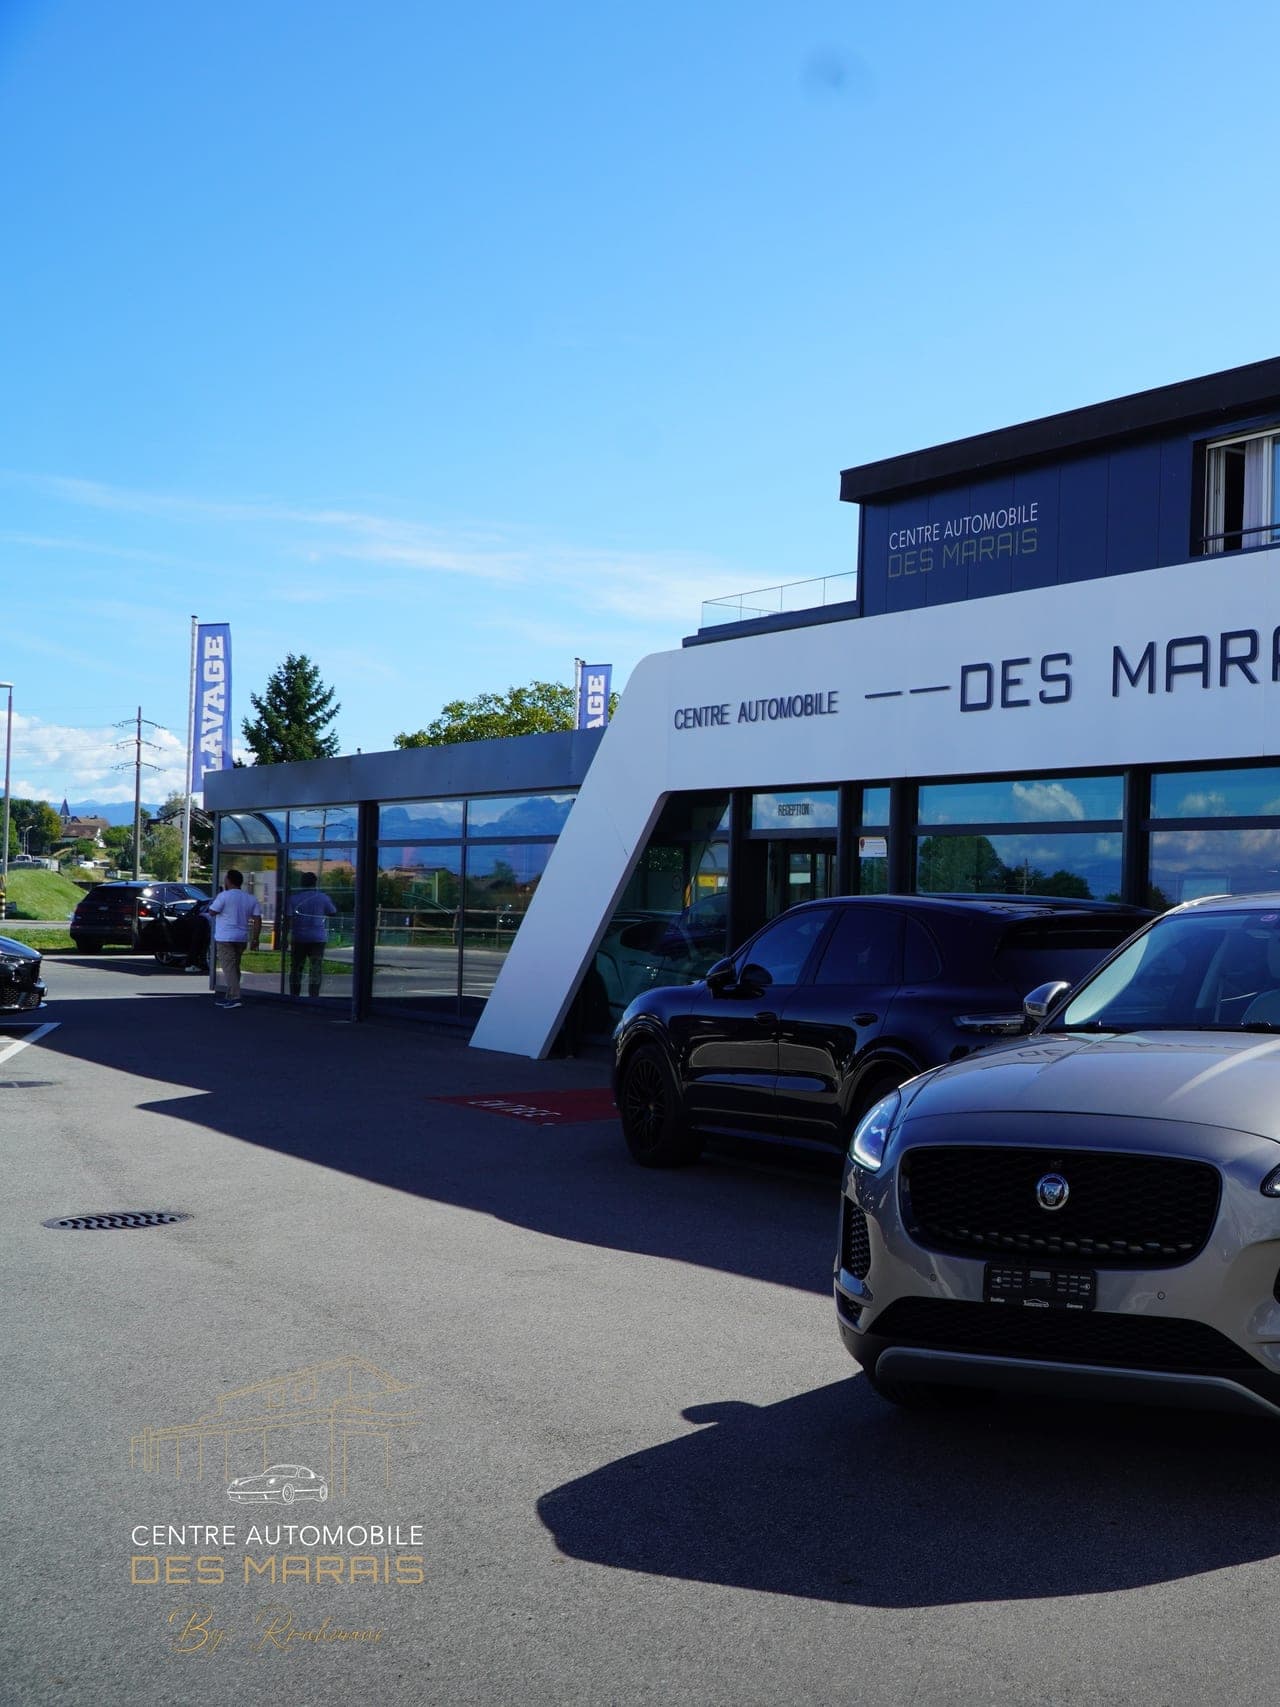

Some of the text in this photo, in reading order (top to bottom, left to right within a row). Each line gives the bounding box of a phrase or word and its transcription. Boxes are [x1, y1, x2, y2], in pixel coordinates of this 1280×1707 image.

[889, 502, 1038, 550] CENTRE AUTOMOBILE
[888, 527, 1038, 578] DES MARAIS
[674, 703, 730, 730] CENTRE
[737, 690, 839, 723] AUTOMOBILE
[959, 652, 1073, 713] DES
